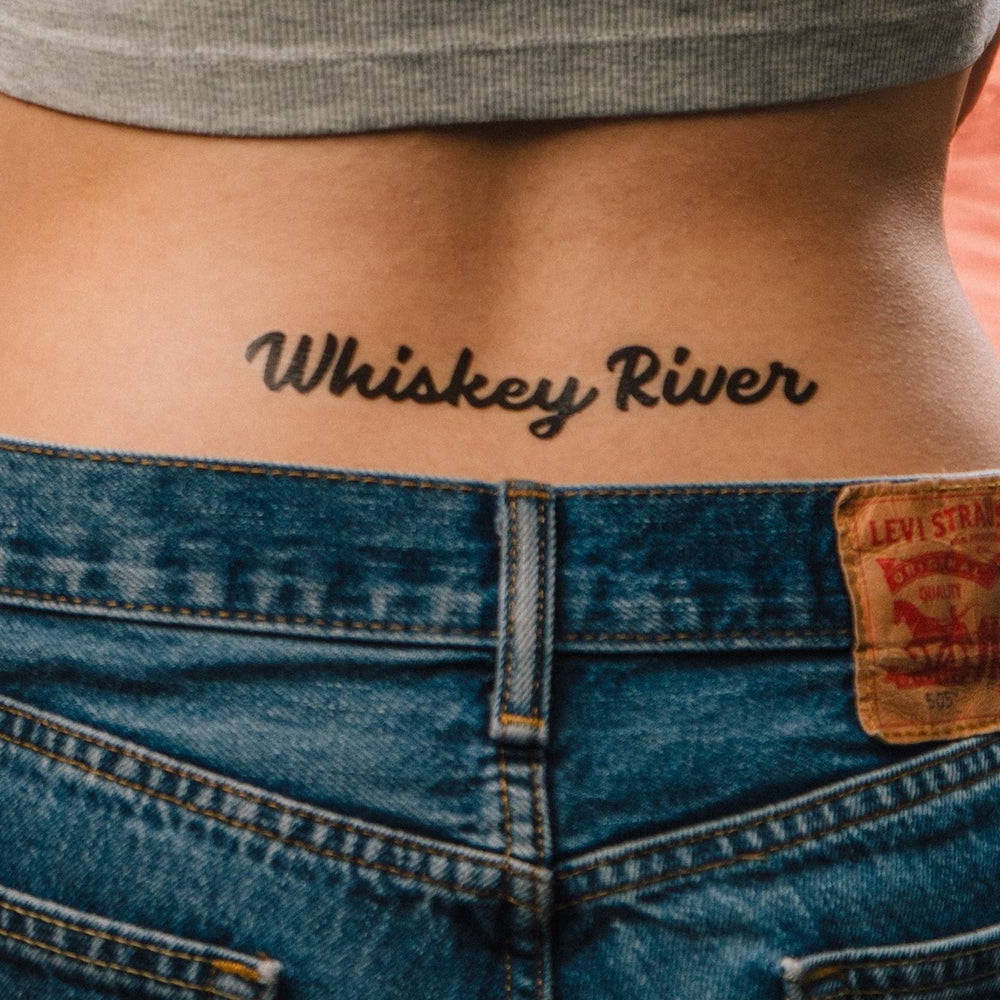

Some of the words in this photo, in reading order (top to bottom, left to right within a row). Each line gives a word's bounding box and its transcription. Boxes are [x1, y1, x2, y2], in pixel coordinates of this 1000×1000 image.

[245, 331, 599, 440] Whiskey
[607, 345, 818, 412] River
[869, 516, 926, 546] LEVI
